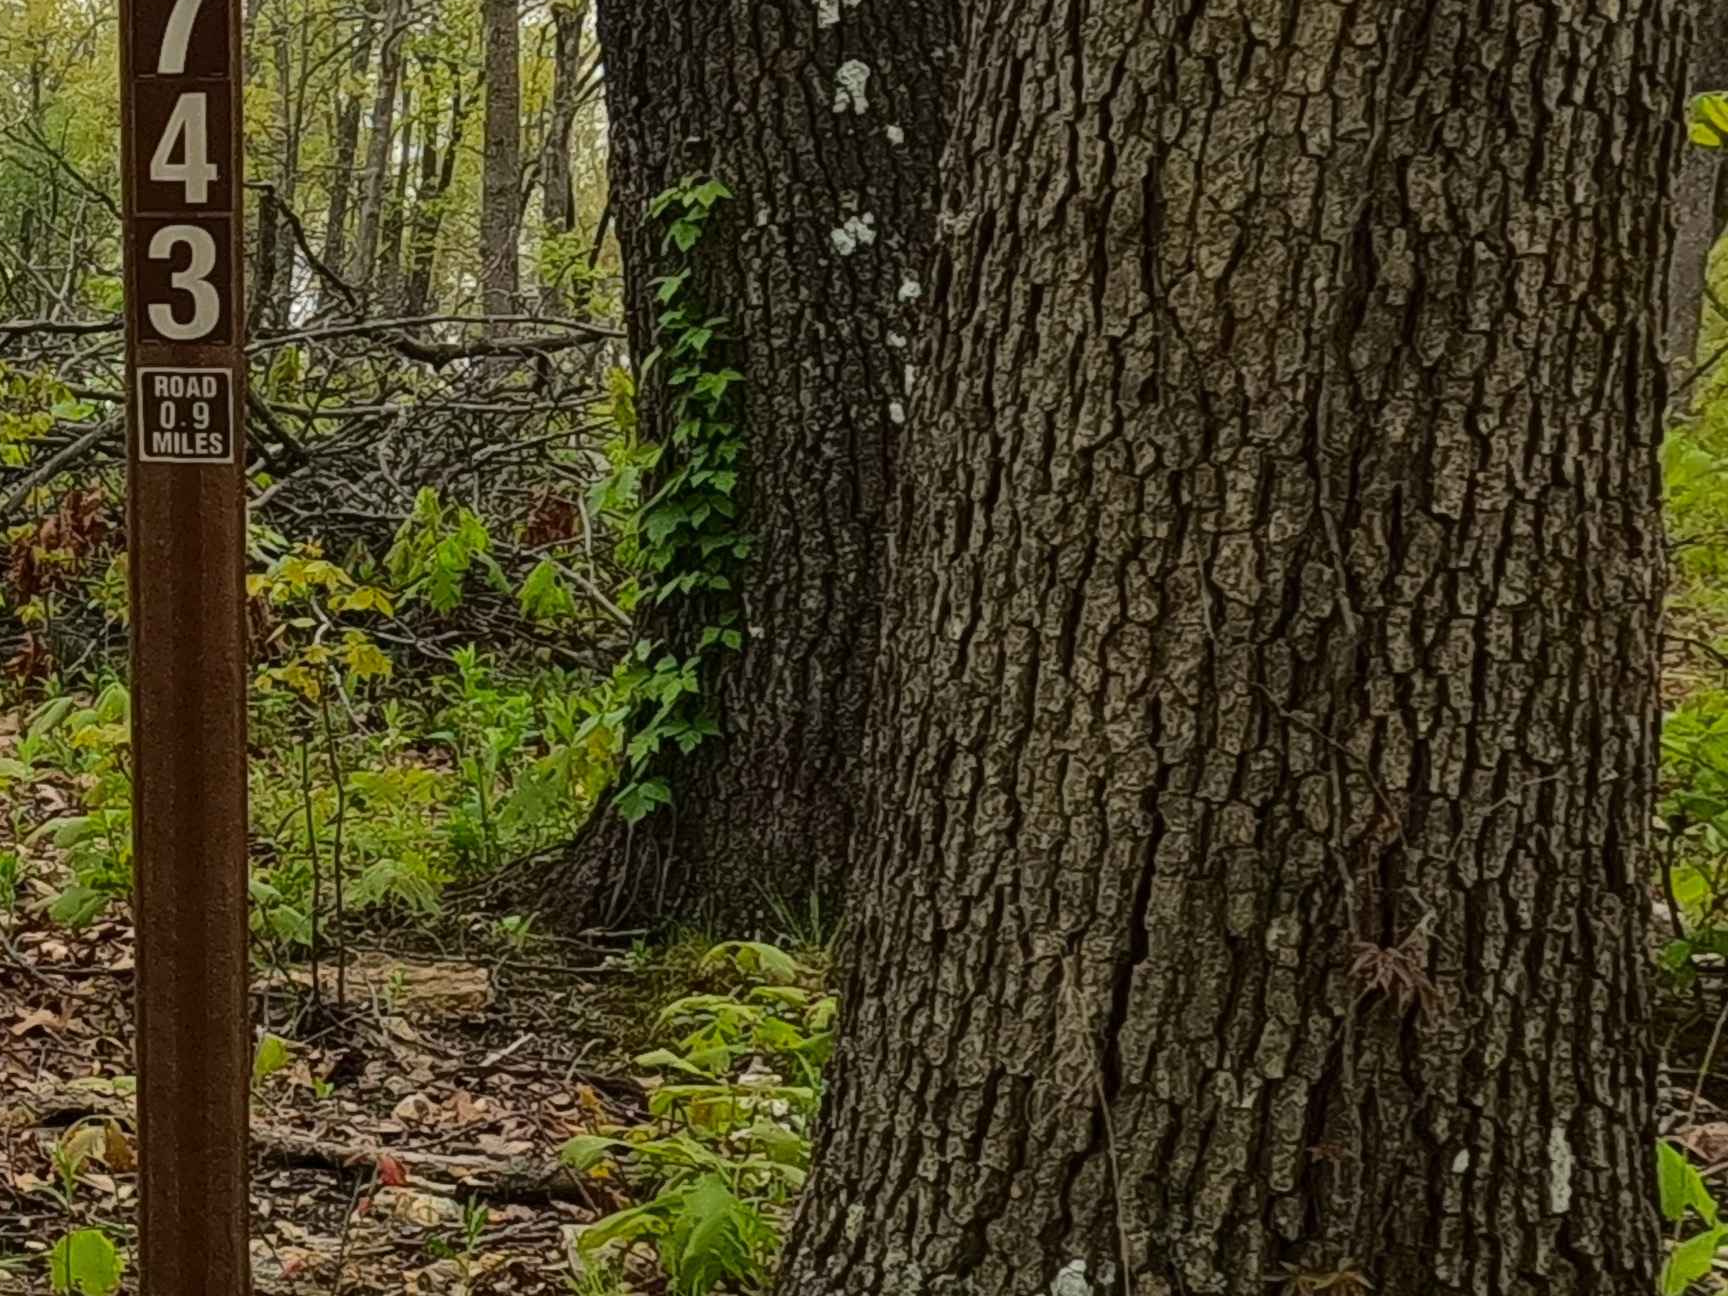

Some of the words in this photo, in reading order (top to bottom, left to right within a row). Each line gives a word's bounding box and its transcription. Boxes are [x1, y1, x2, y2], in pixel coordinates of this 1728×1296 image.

[153, 375, 218, 399] ROAD
[159, 400, 211, 430] 0.9
[152, 431, 224, 455] MILES
